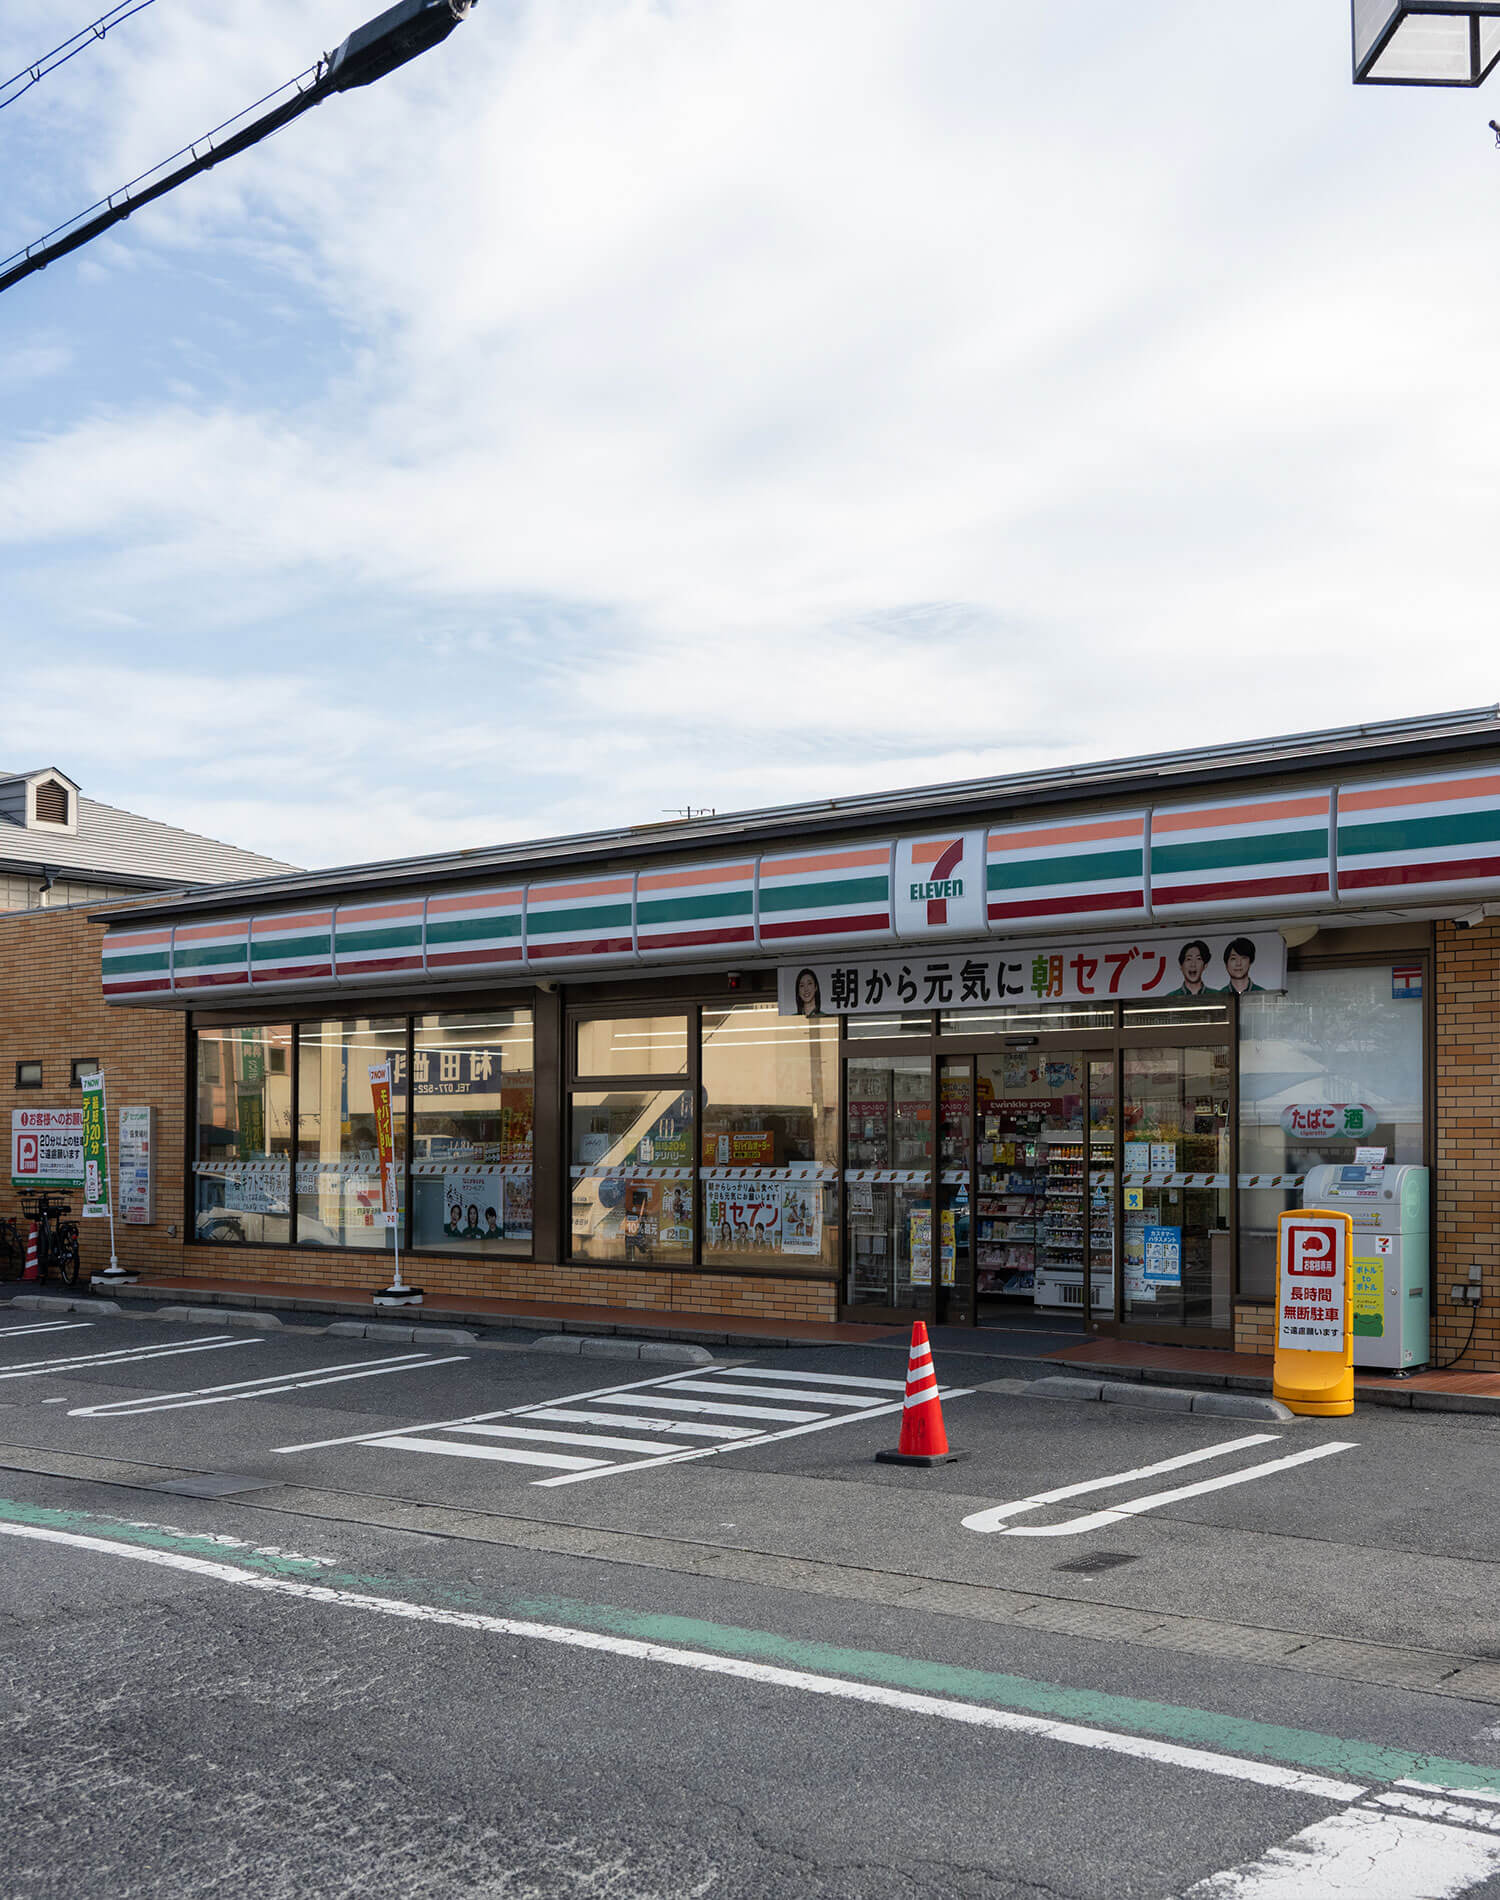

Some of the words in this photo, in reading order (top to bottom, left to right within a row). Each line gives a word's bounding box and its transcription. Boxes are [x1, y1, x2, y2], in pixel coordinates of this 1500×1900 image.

[990, 1100, 1027, 1109] twinkle
[1030, 1101, 1051, 1109] pop
[1291, 1108, 1335, 1129] たばこ
[1343, 1108, 1364, 1129] 酒
[710, 1200, 778, 1228] 朝セブン
[1290, 1286, 1332, 1302] 長時間
[1283, 1305, 1339, 1322] 無断駐車
[1283, 1326, 1339, 1336] ご遠慮願います
